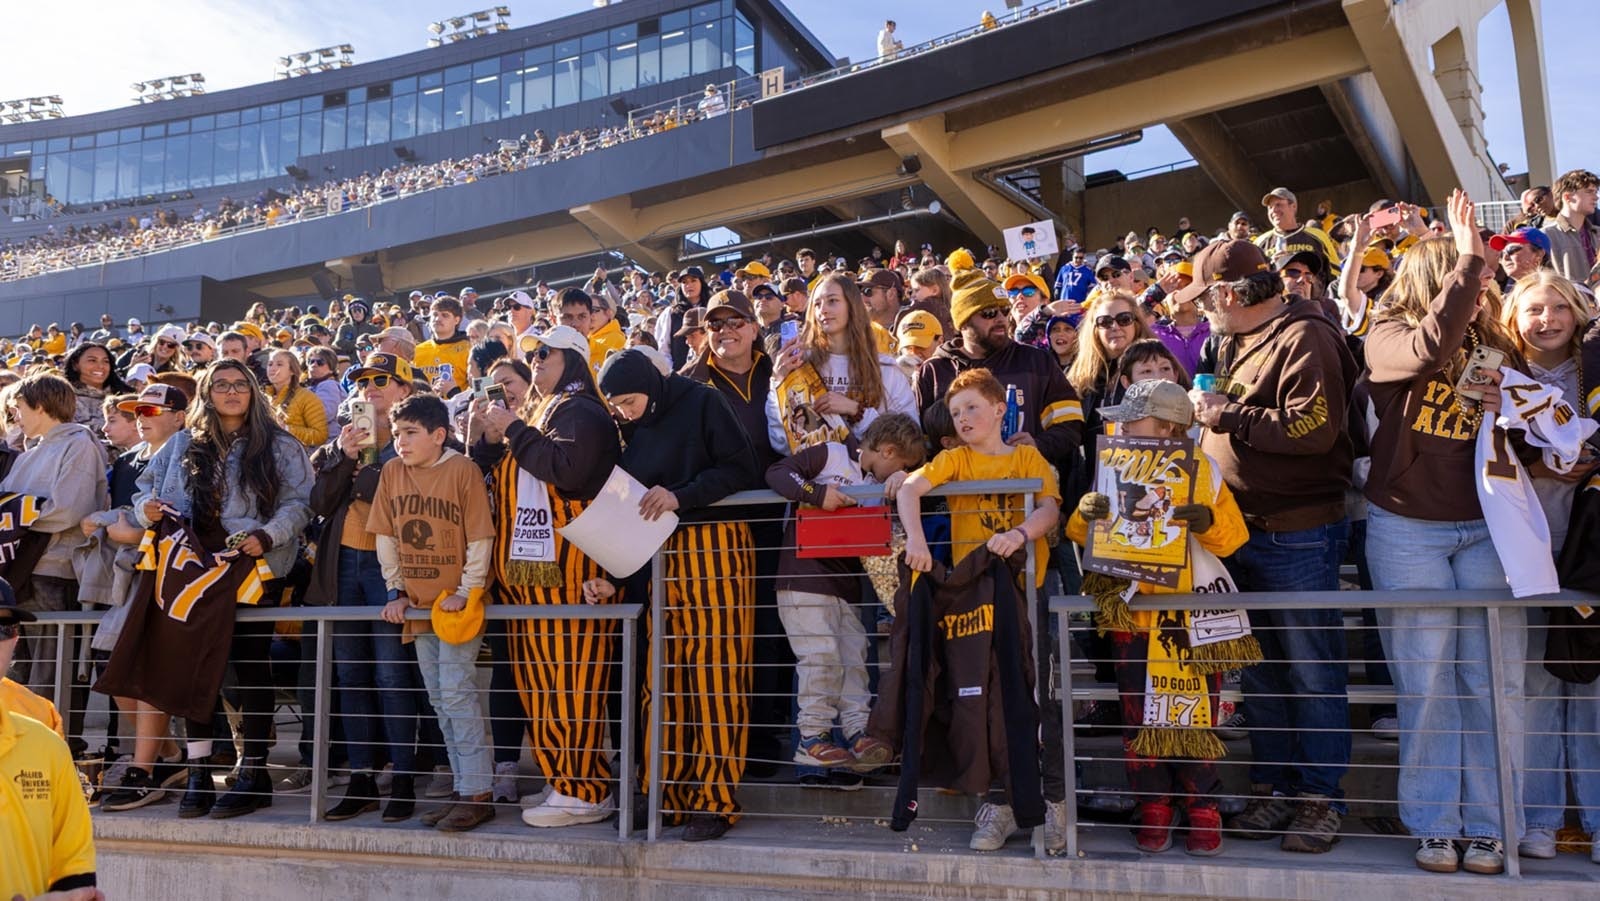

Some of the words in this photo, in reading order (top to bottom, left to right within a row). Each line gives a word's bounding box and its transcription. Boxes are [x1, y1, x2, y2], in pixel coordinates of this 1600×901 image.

[766, 76, 778, 96] H
[330, 196, 340, 212] G
[1068, 271, 1082, 287] 17
[1423, 380, 1453, 406] 17
[1411, 405, 1478, 441] ALL
[516, 507, 548, 527] 7220
[520, 529, 551, 540] POKES
[1152, 675, 1168, 689] DO
[1170, 677, 1201, 691] GOOD
[1152, 692, 1201, 727] 17
